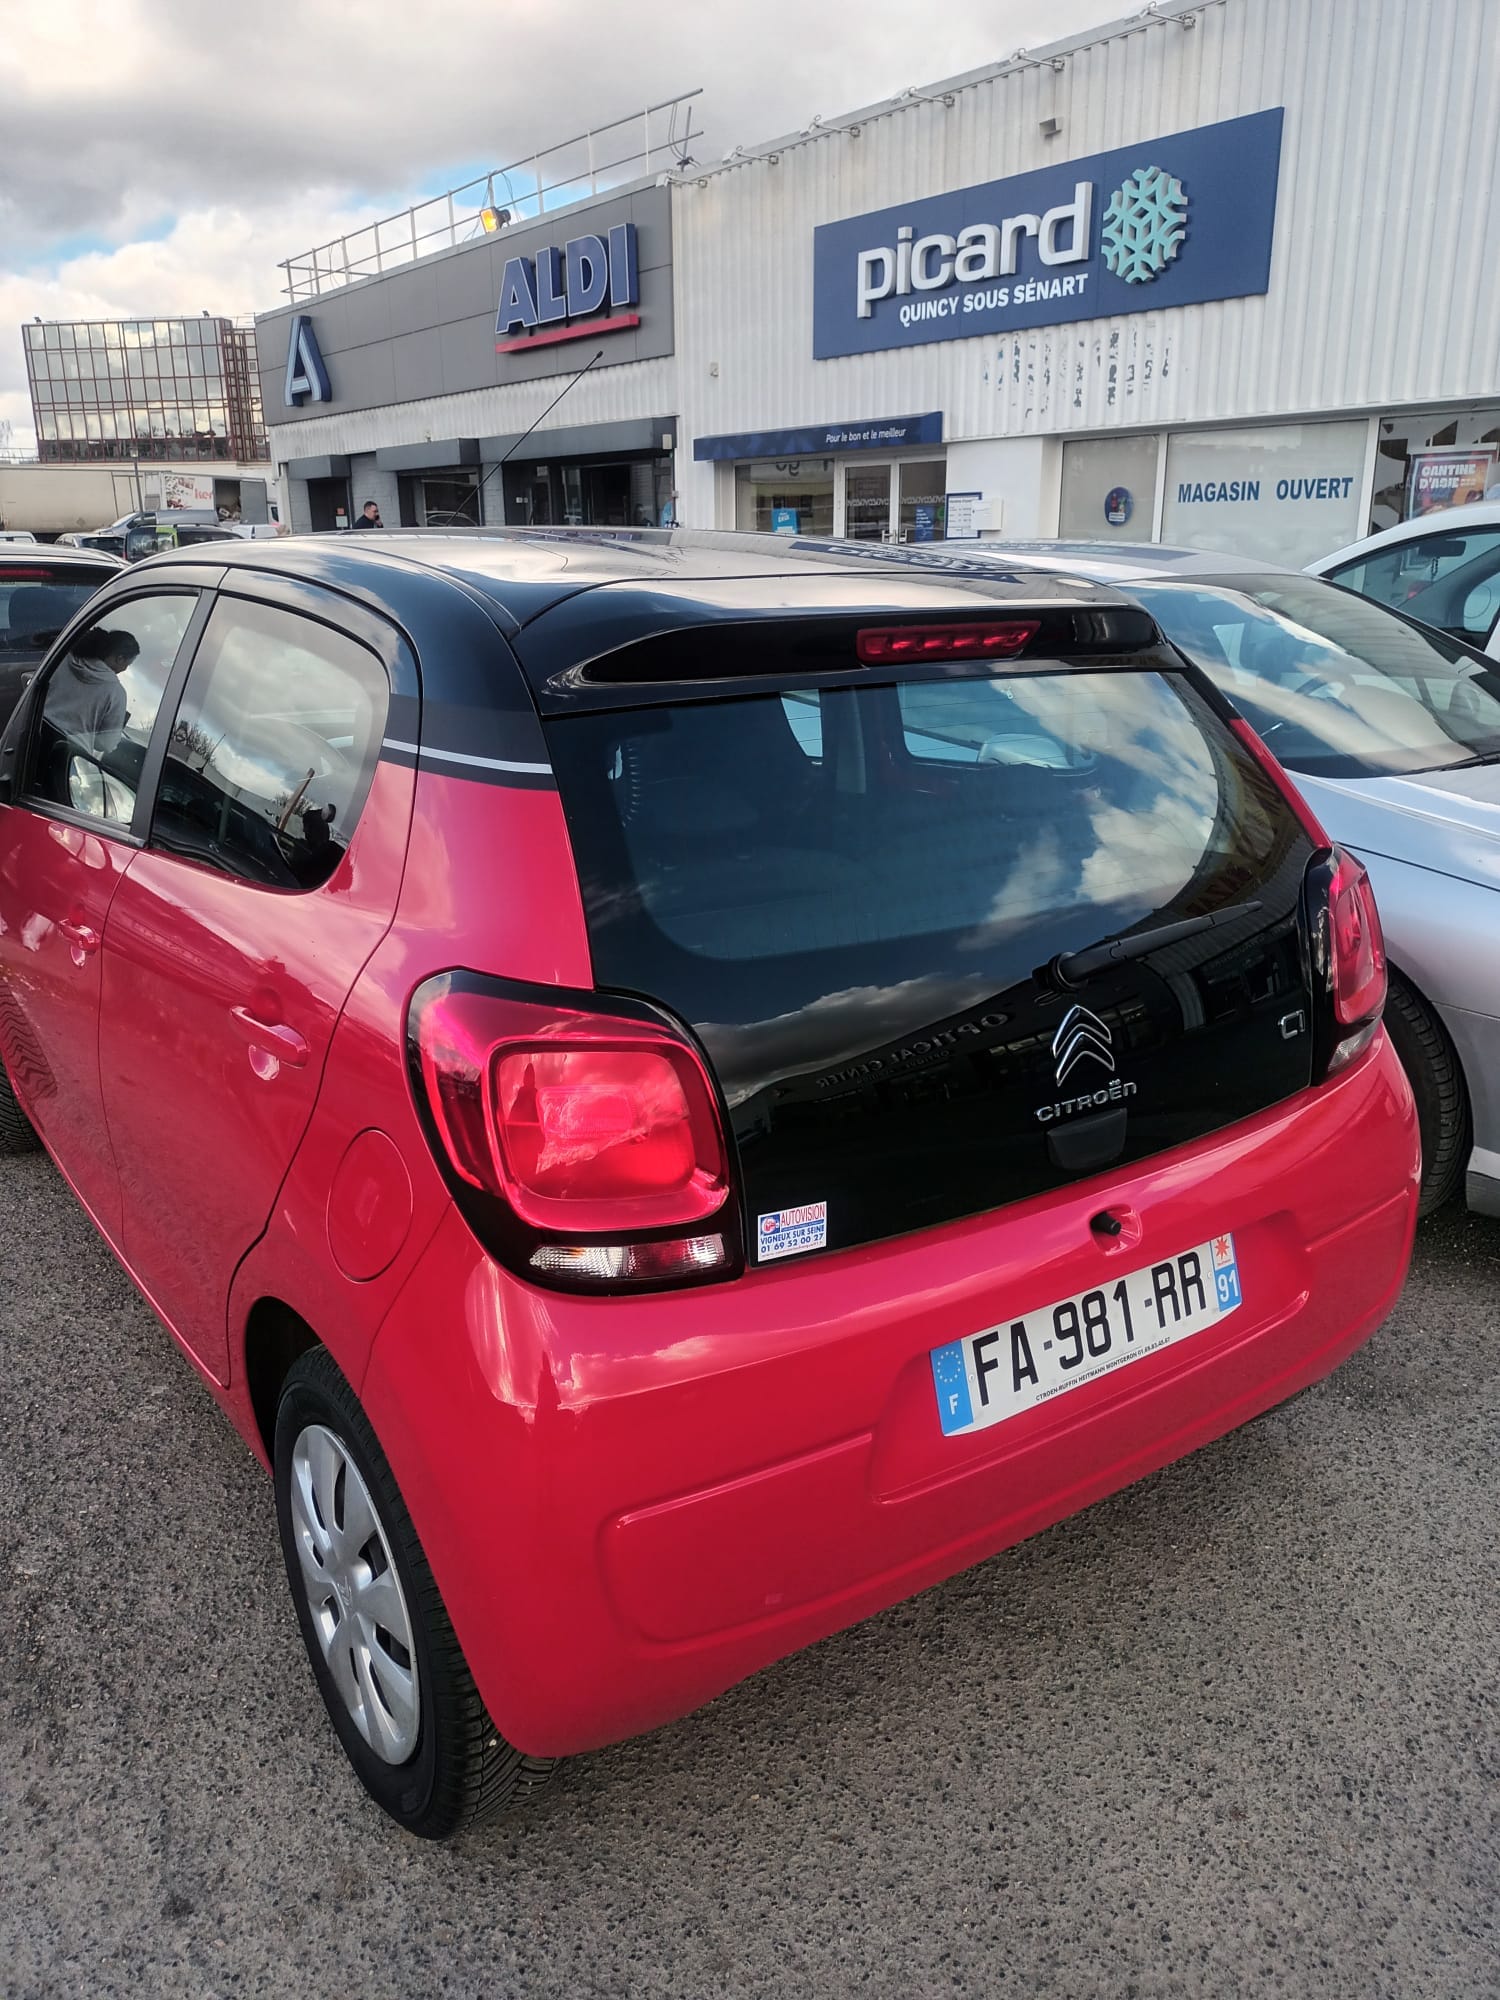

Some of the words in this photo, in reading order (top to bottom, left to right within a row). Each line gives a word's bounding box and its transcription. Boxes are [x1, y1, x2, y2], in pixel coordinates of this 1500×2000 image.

[857, 181, 1093, 318] picard
[495, 223, 638, 335] ALDI
[900, 296, 959, 328] QUINCY
[963, 287, 1009, 313] SOUS
[1013, 273, 1088, 304] SÉNART
[825, 433, 841, 443] Pour
[841, 432, 848, 442] le
[848, 431, 861, 441] bon
[862, 430, 870, 440] et
[870, 429, 877, 439] le
[878, 426, 906, 439] meilleur
[1421, 463, 1477, 477] CANTINE
[1177, 481, 1260, 503] MAGASIN
[1276, 477, 1353, 500] OUVERT
[1419, 477, 1459, 489] D'ASIE
[781, 1203, 825, 1227] AUTOVISION
[760, 1232, 791, 1245] VIGNEUX
[792, 1229, 806, 1239] SUR
[807, 1224, 825, 1235] SEINE
[774, 1242, 785, 1250] 69
[787, 1239, 798, 1248] 52
[801, 1236, 811, 1244] 00
[814, 1233, 824, 1242] 27
[1218, 1269, 1239, 1303] 91
[948, 1392, 959, 1415] F
